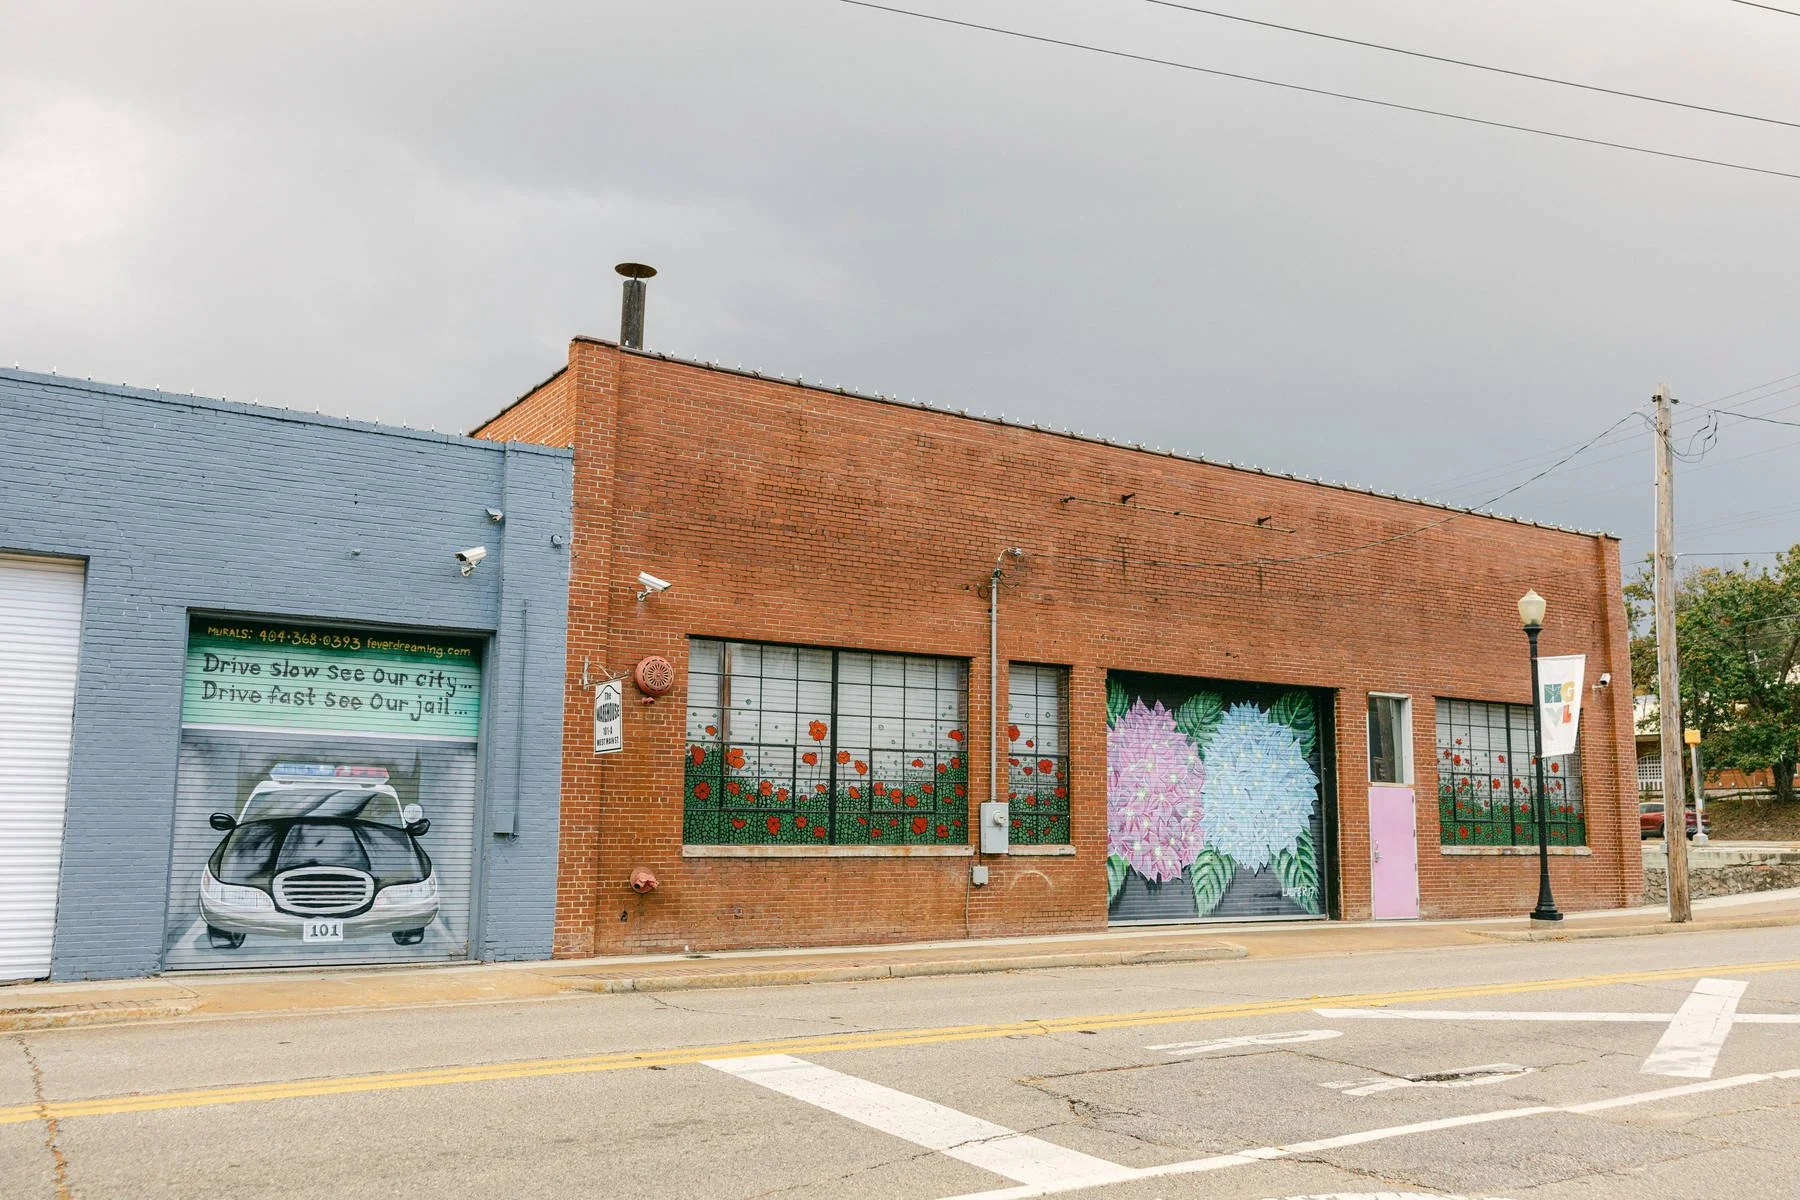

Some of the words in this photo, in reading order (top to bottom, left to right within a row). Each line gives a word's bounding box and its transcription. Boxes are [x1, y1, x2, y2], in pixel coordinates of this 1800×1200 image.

[208, 626, 253, 640] MURALS:
[367, 638, 471, 658] feverdreaming.com
[203, 652, 261, 675] Drive
[201, 680, 262, 703] Drive
[267, 685, 317, 706] fast
[606, 737, 614, 745] MAIN
[309, 924, 340, 937] 101
